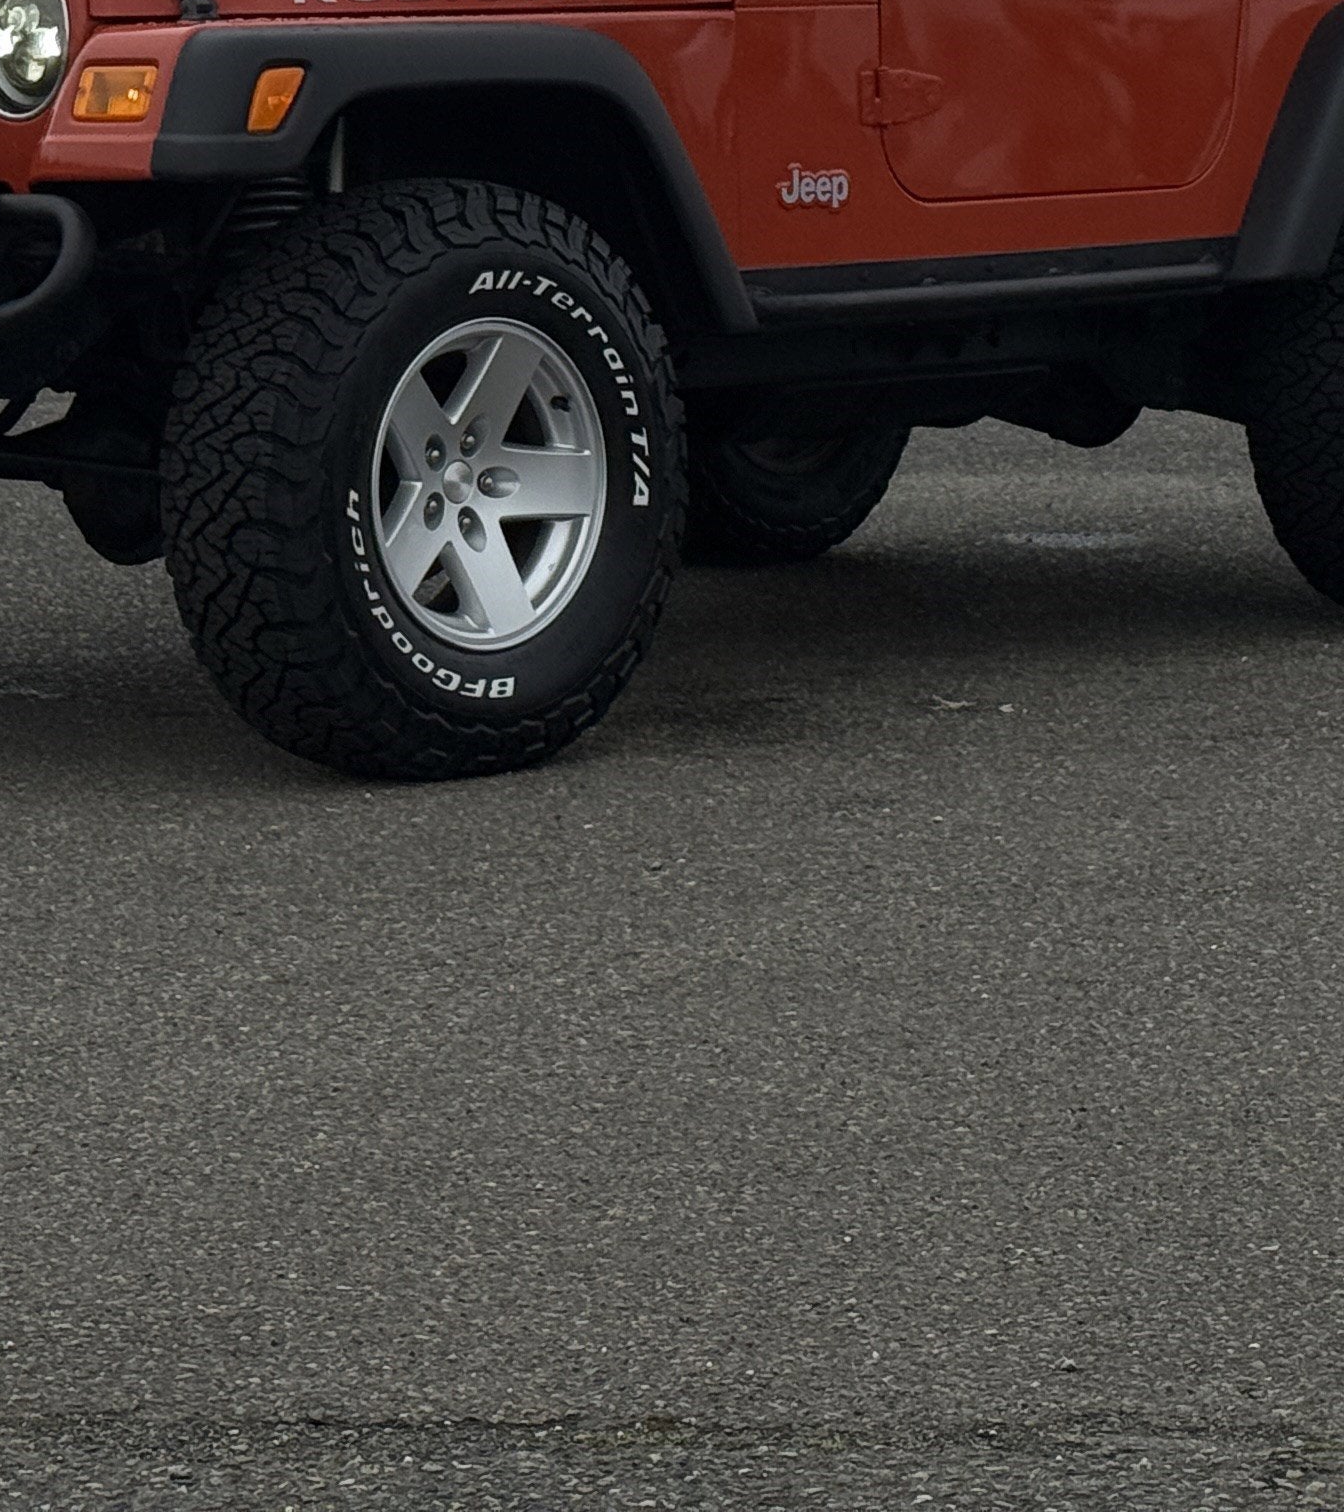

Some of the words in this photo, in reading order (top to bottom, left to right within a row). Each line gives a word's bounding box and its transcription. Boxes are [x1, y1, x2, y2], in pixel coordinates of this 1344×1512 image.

[780, 165, 850, 209] Jeep
[468, 269, 640, 416] All-Terrain
[630, 426, 651, 507] T/A
[346, 488, 516, 699] BFGoodrich
